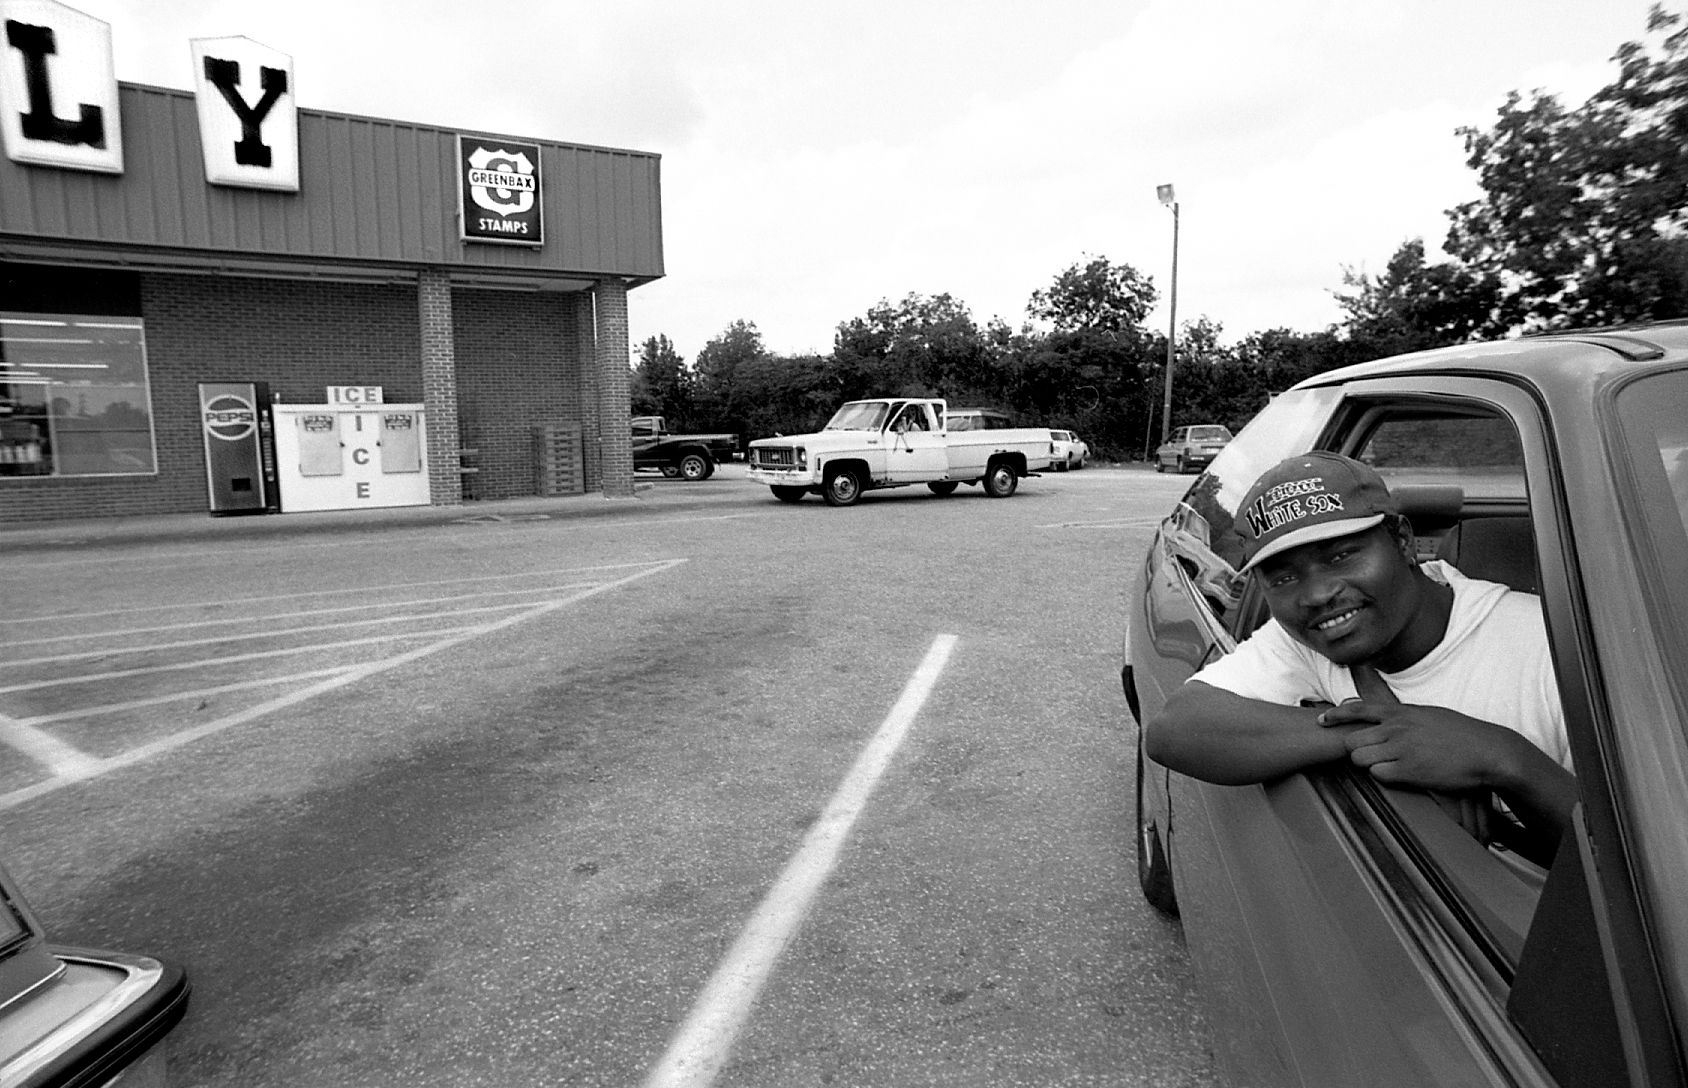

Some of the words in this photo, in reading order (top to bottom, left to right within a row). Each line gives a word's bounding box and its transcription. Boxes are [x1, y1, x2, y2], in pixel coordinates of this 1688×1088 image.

[471, 171, 532, 189] GREENBAX
[479, 218, 529, 234] STAMPS
[333, 387, 377, 402] ICE
[352, 415, 371, 499] ICE
[1306, 493, 1344, 515] SOX
